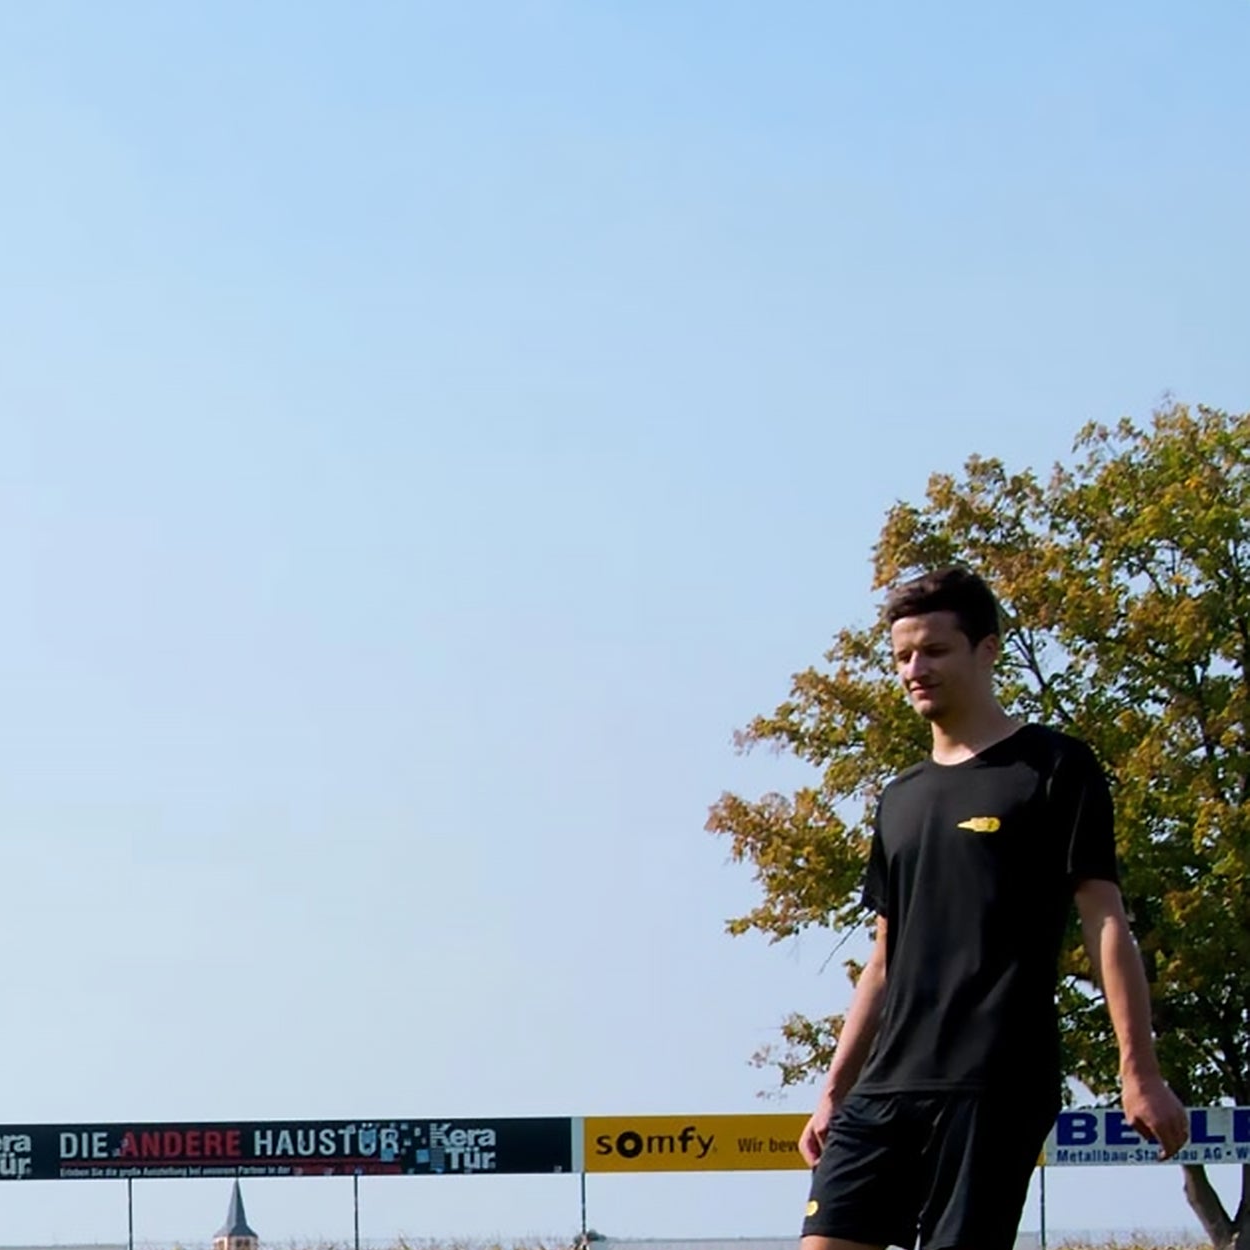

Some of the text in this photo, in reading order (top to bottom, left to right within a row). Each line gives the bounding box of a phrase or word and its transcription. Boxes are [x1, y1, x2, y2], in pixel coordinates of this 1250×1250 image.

[60, 1122, 400, 1159] DIE ANDERE HAUSTÜR
[430, 1122, 496, 1147] Kera
[595, 1126, 715, 1159] somfy
[1056, 1110, 1250, 1146] BEL
[445, 1146, 496, 1170] Tür
[737, 1137, 763, 1153] Wir
